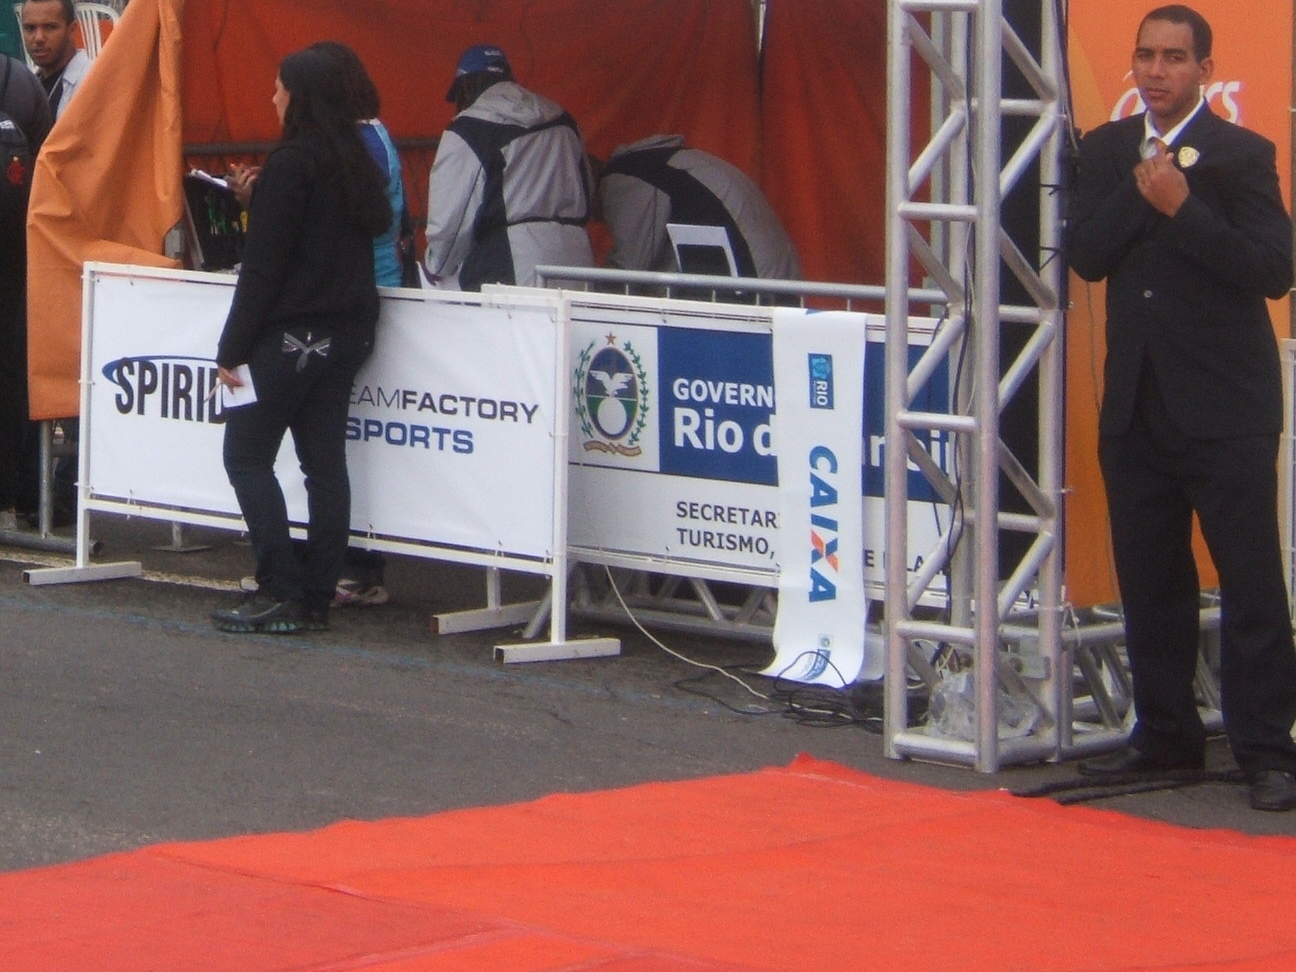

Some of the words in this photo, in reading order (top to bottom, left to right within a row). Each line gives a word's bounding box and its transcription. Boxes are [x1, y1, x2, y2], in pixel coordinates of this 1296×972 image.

[114, 356, 227, 425] SPIRID
[351, 384, 540, 424] AMFACTORY
[672, 377, 773, 408] GOVERN
[816, 379, 829, 406] RIO
[346, 417, 474, 454] SPORTS
[673, 406, 744, 454] Rio
[676, 500, 781, 529] SECRETAR
[808, 445, 840, 603] CAIXA
[676, 527, 775, 559] TURISMO,
